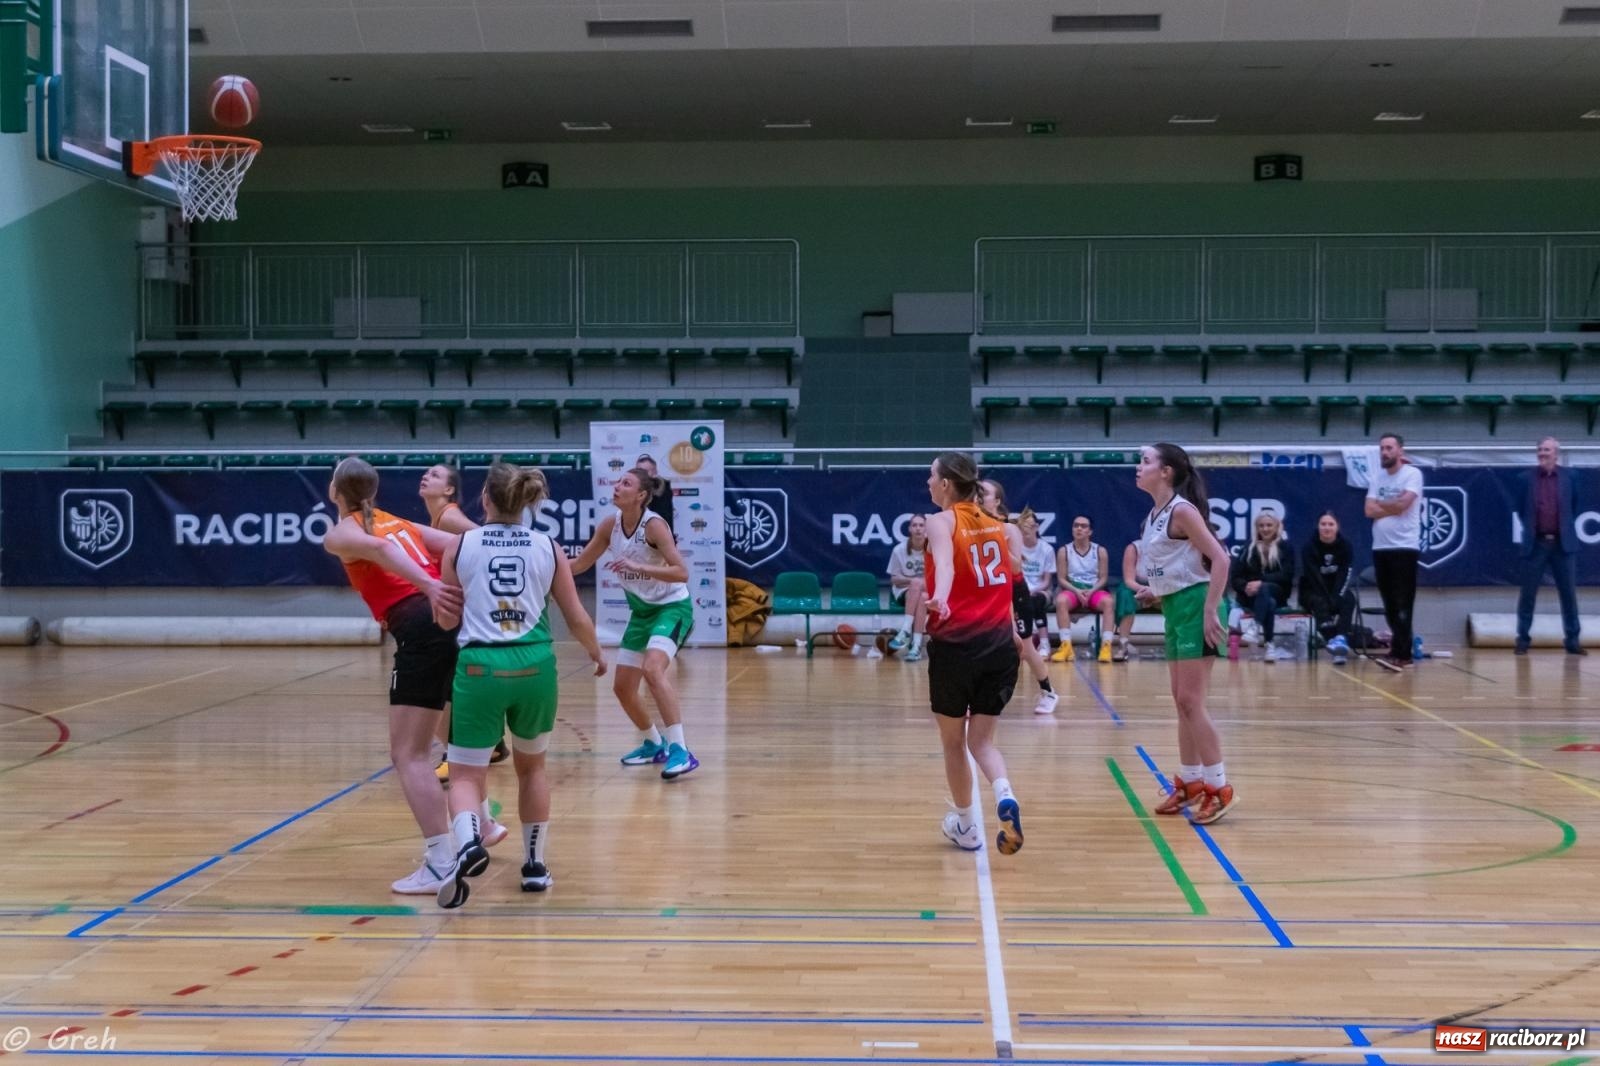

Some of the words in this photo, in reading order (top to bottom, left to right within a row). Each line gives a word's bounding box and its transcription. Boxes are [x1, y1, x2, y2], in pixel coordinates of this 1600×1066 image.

[1260, 163, 1275, 178] B
[1285, 162, 1298, 177] B
[505, 171, 518, 185] A
[525, 171, 544, 185] A
[175, 502, 334, 545] RACIBÓ
[1206, 498, 1289, 541] SiR
[481, 538, 532, 548] RACIBÓRZ
[970, 540, 1007, 588] 12
[488, 555, 526, 597] 3
